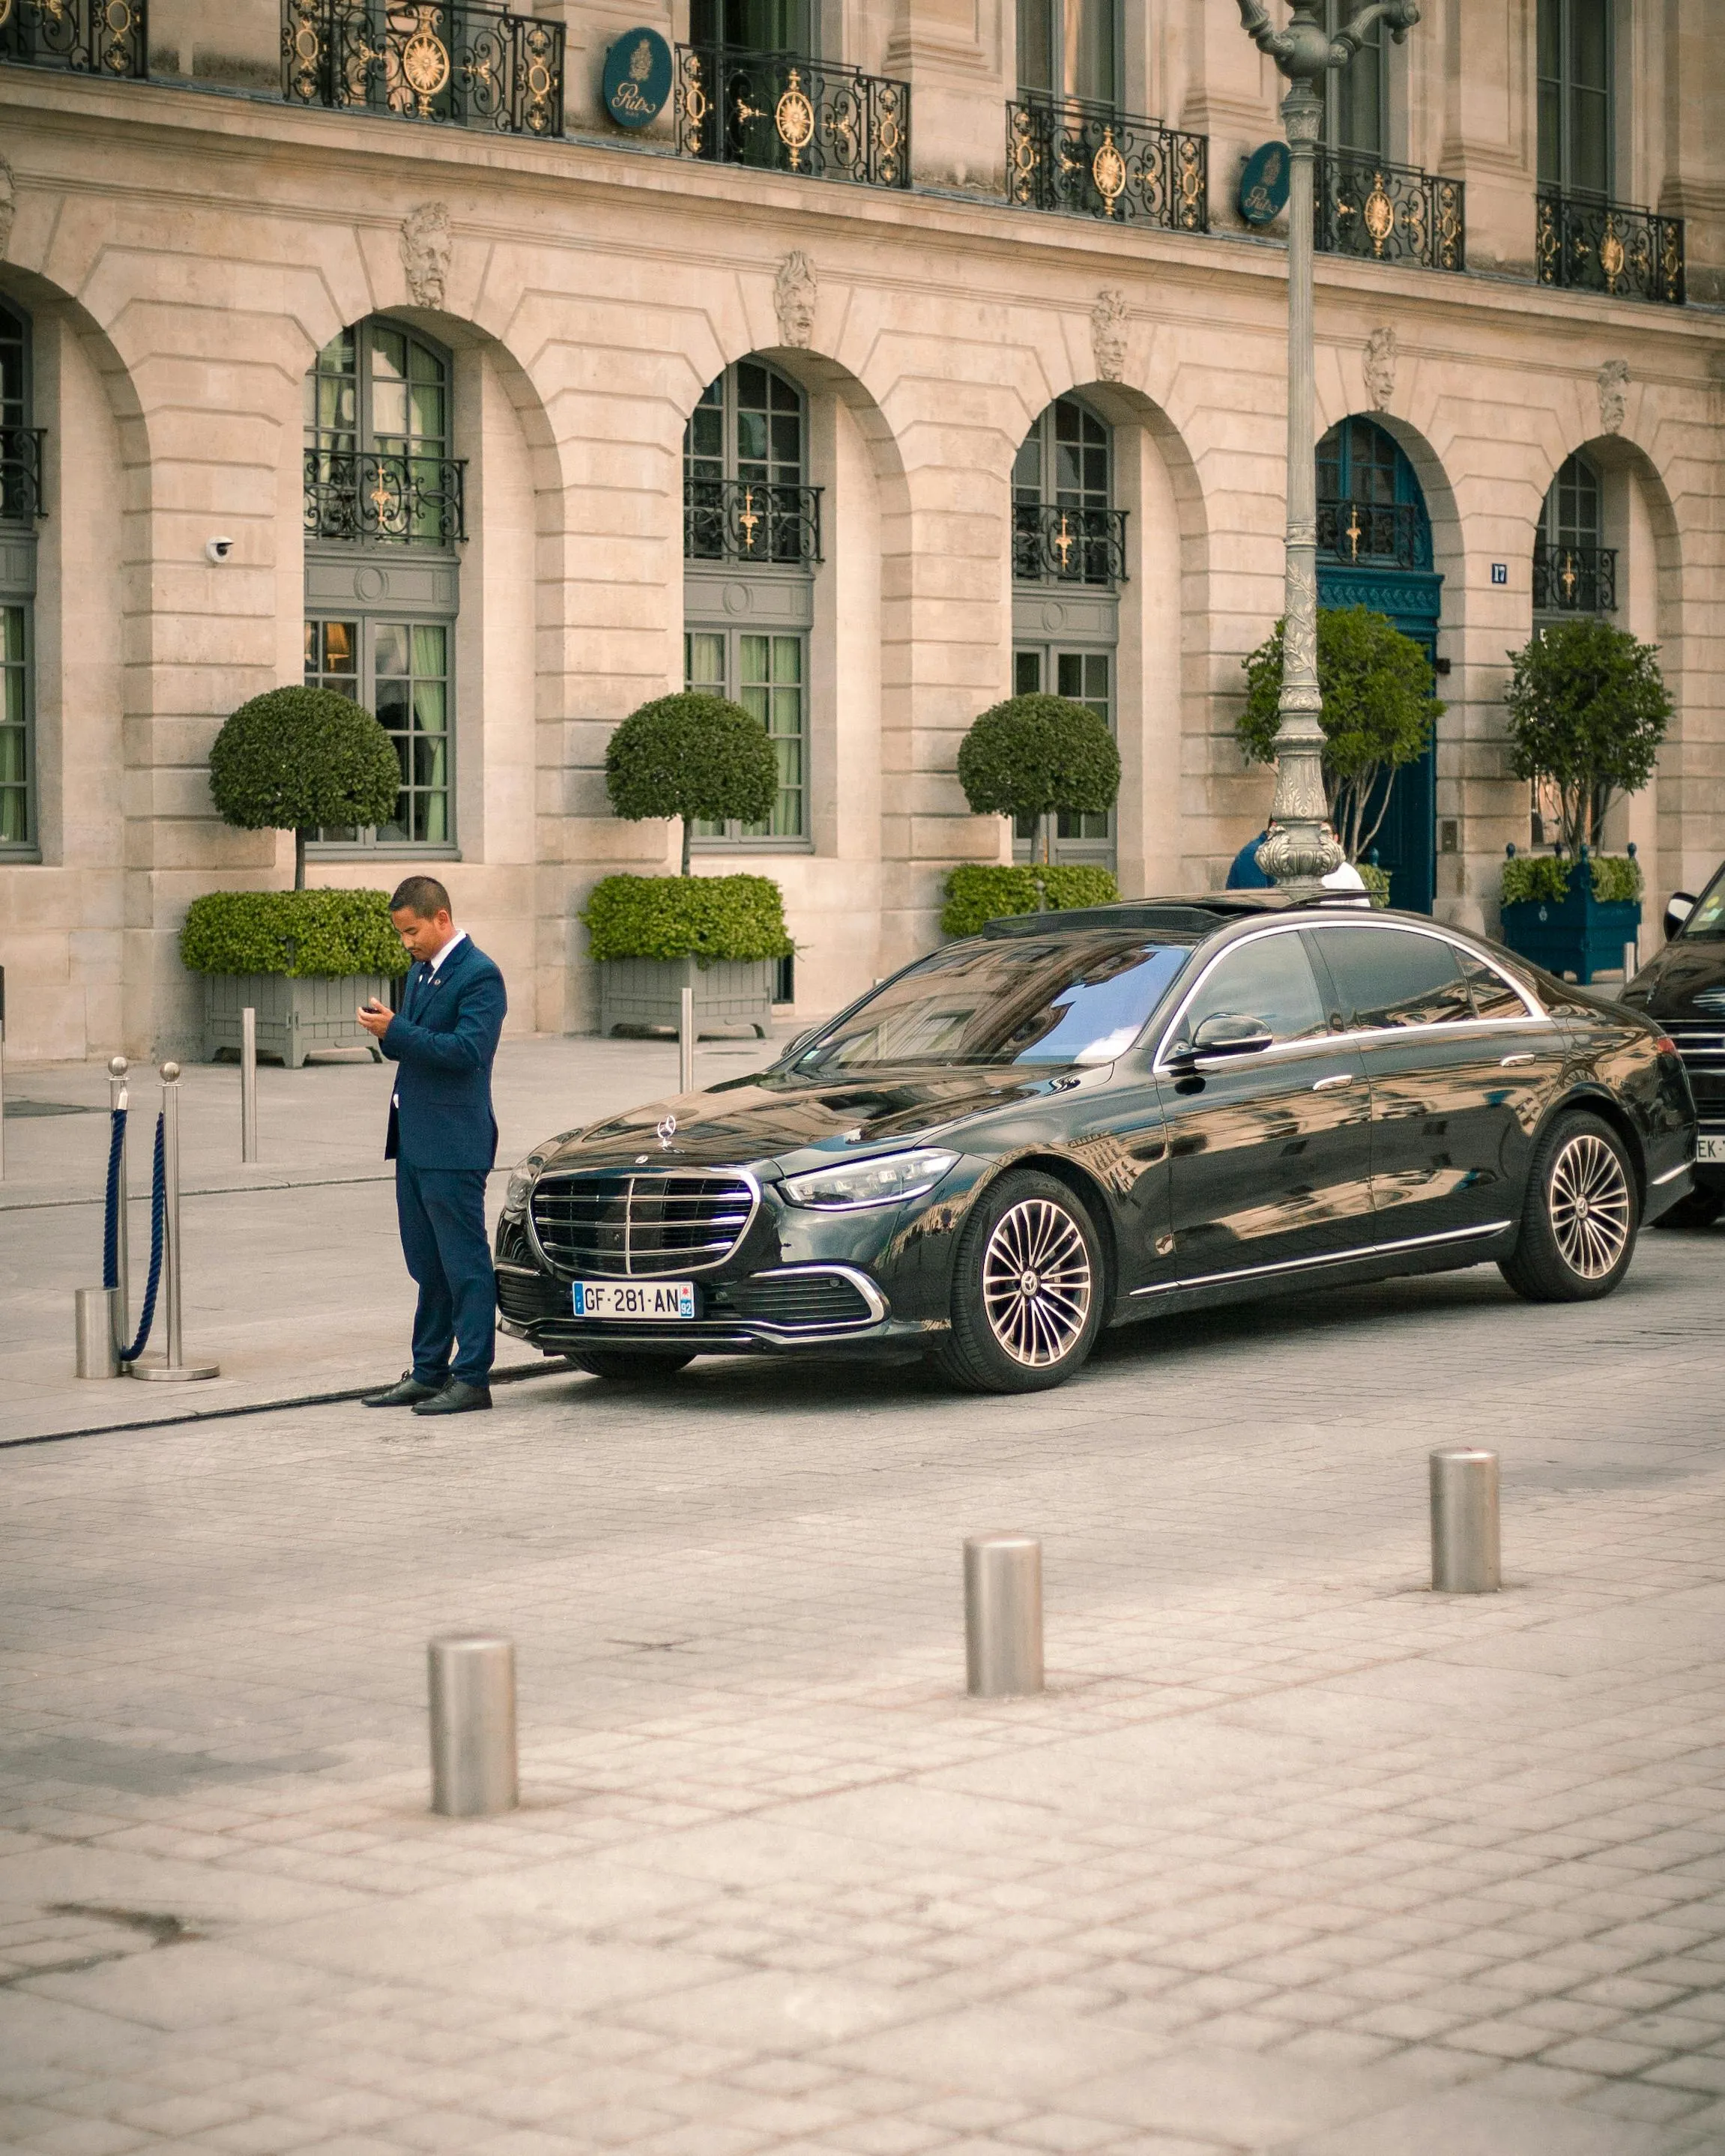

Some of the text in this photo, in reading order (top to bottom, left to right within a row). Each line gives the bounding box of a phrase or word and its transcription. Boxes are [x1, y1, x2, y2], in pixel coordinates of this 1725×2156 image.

[611, 82, 656, 114] Ritz
[1494, 566, 1505, 582] 17
[1698, 1140, 1725, 1158] EK-
[585, 1288, 679, 1312] GF-281-AN
[681, 1302, 692, 1315] 92
